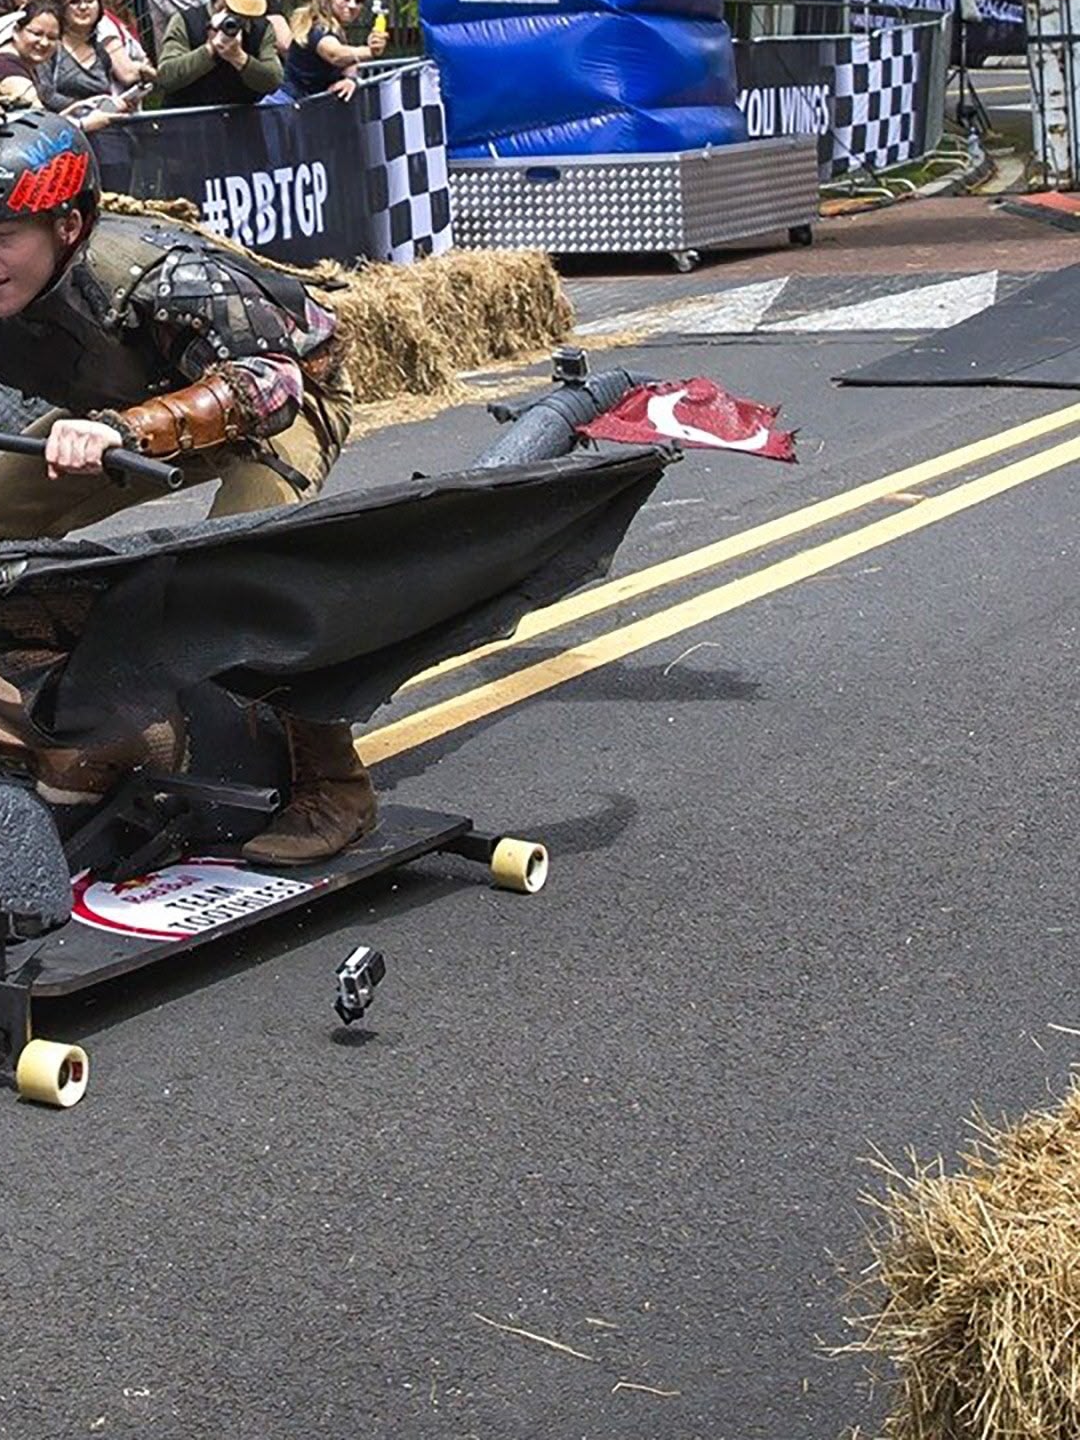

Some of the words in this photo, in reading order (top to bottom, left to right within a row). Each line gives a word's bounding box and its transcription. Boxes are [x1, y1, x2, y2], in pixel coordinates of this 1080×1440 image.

[779, 84, 829, 135] WINGS
[200, 161, 328, 246] #RBTGP
[165, 885, 244, 911] TEAM
